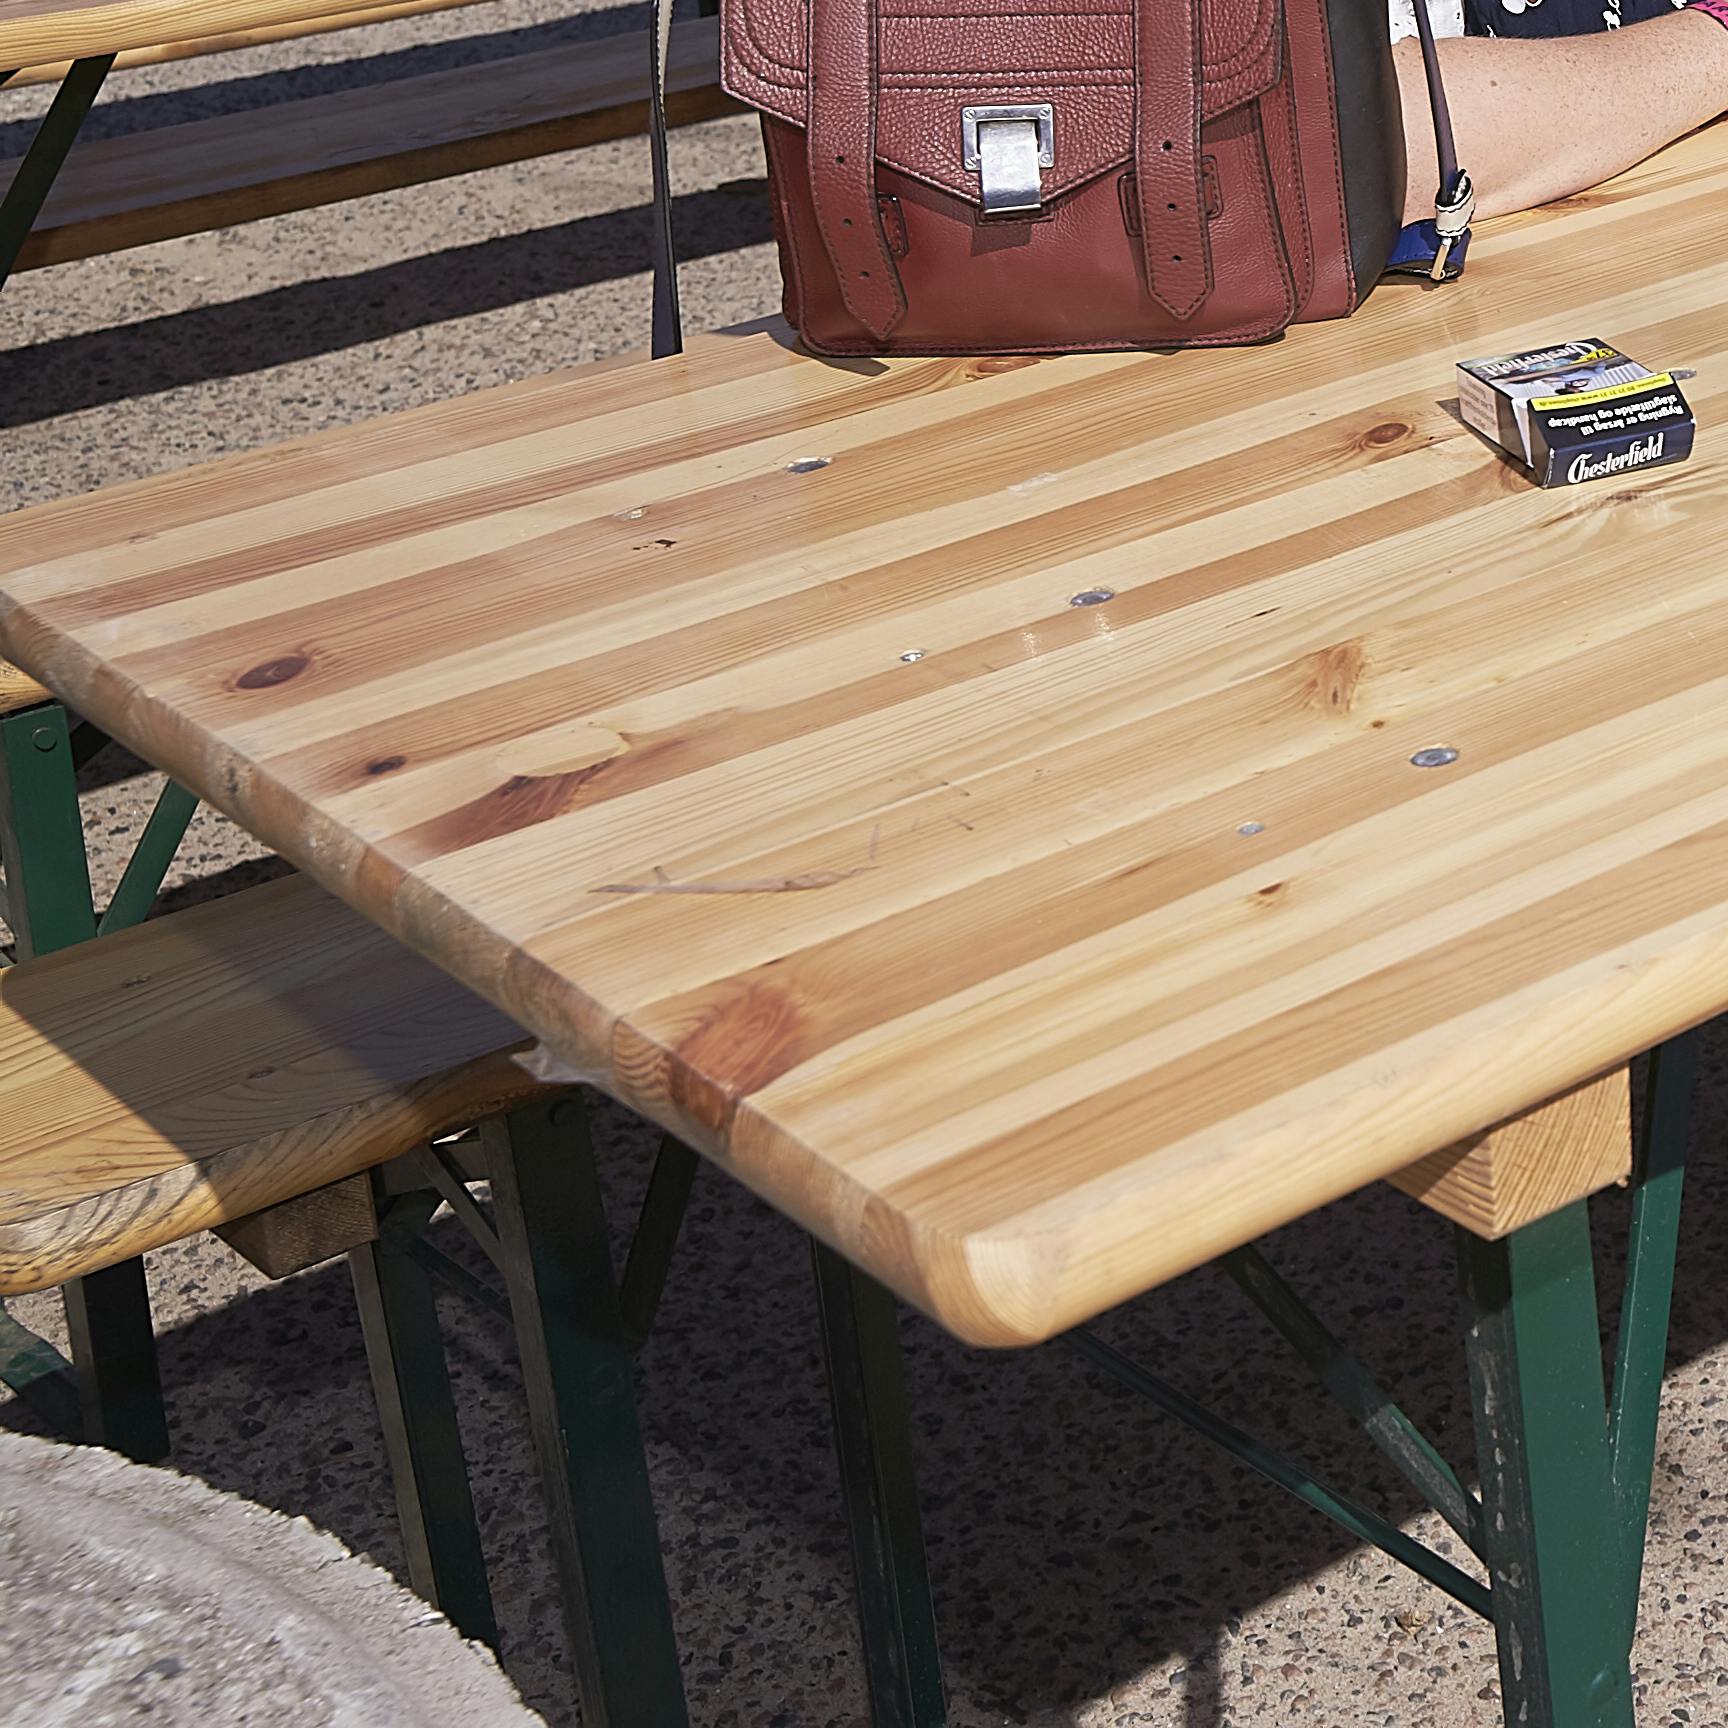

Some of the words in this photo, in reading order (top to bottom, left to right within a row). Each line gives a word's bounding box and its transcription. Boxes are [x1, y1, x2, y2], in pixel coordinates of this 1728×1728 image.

[1483, 342, 1597, 376] Chesterfield
[1598, 408, 1614, 419] og
[1626, 416, 1638, 424] er
[1638, 405, 1684, 422] Rygning
[1548, 413, 1598, 428] handicap
[1593, 419, 1625, 431] årsag
[1580, 425, 1594, 436] til
[1567, 432, 1665, 485] Chesterfield
